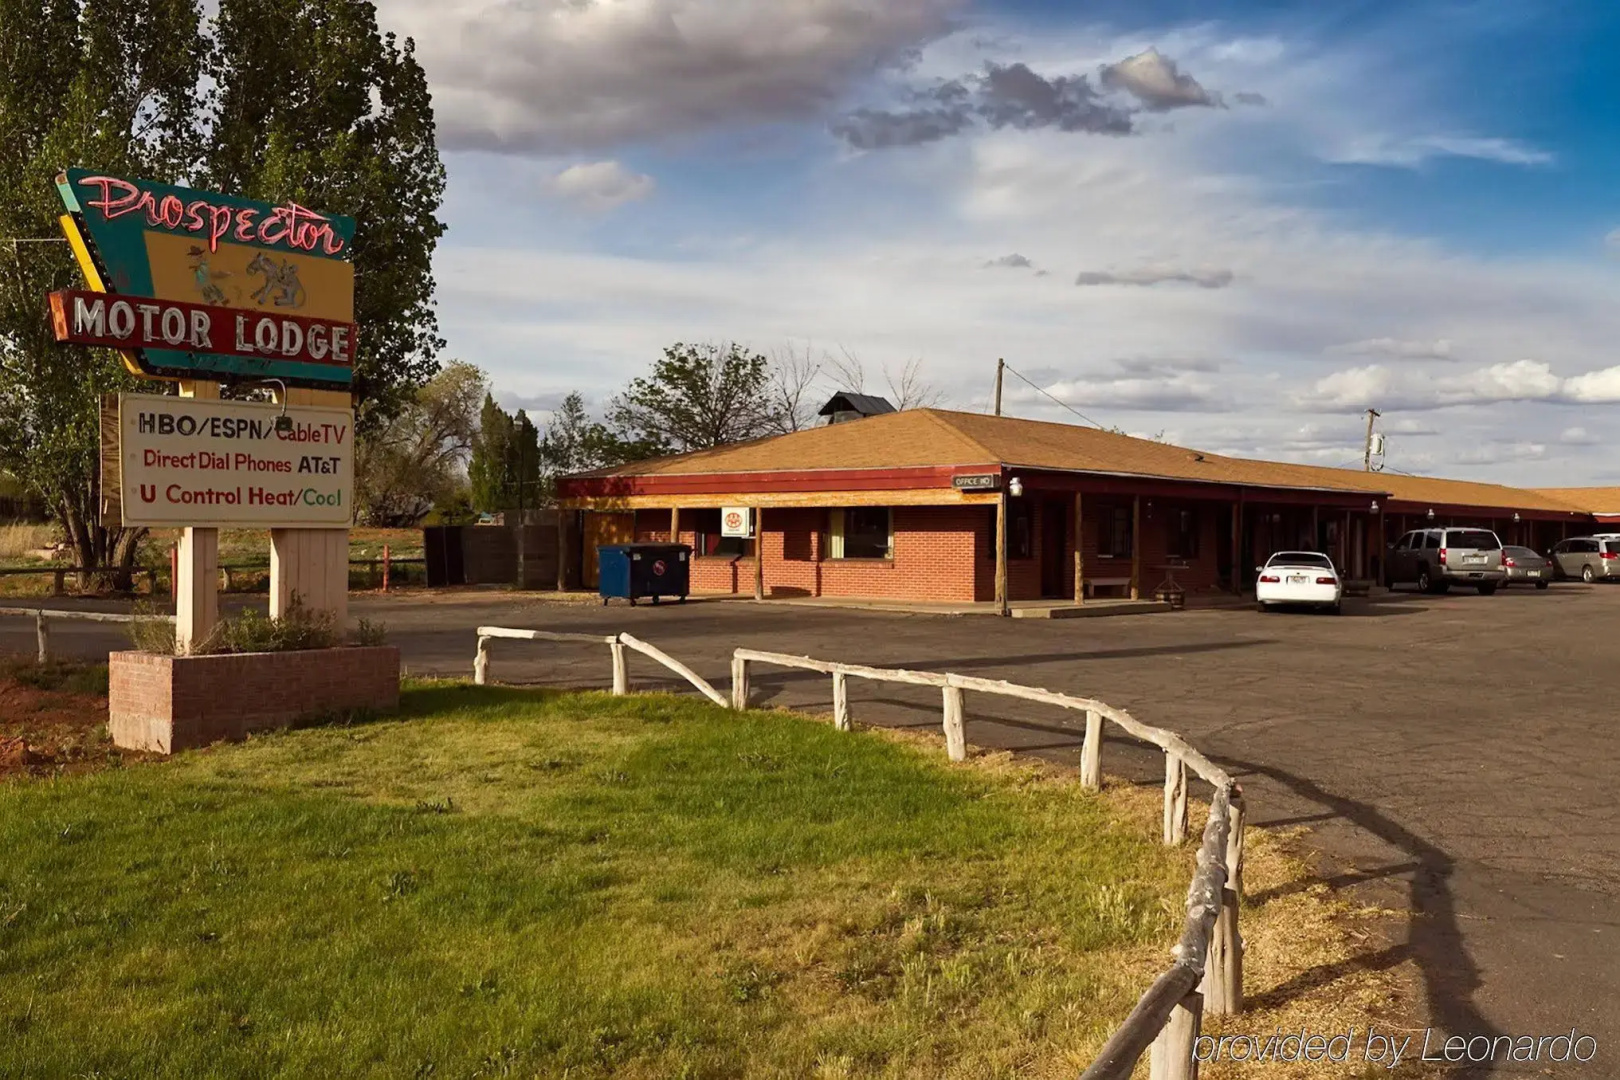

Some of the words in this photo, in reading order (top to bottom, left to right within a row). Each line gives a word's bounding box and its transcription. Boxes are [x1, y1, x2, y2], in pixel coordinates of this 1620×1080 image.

[78, 175, 344, 254] Prospector
[73, 297, 213, 349] MOTOR
[235, 314, 349, 362] LODGE
[143, 449, 197, 469] Direct
[199, 451, 230, 471] Dial
[235, 453, 292, 473] Phones
[297, 456, 341, 474] AT&T
[955, 477, 978, 486] OFFICE
[140, 484, 156, 503] U
[166, 484, 241, 505] Control
[248, 486, 341, 507] Heat/Cool
